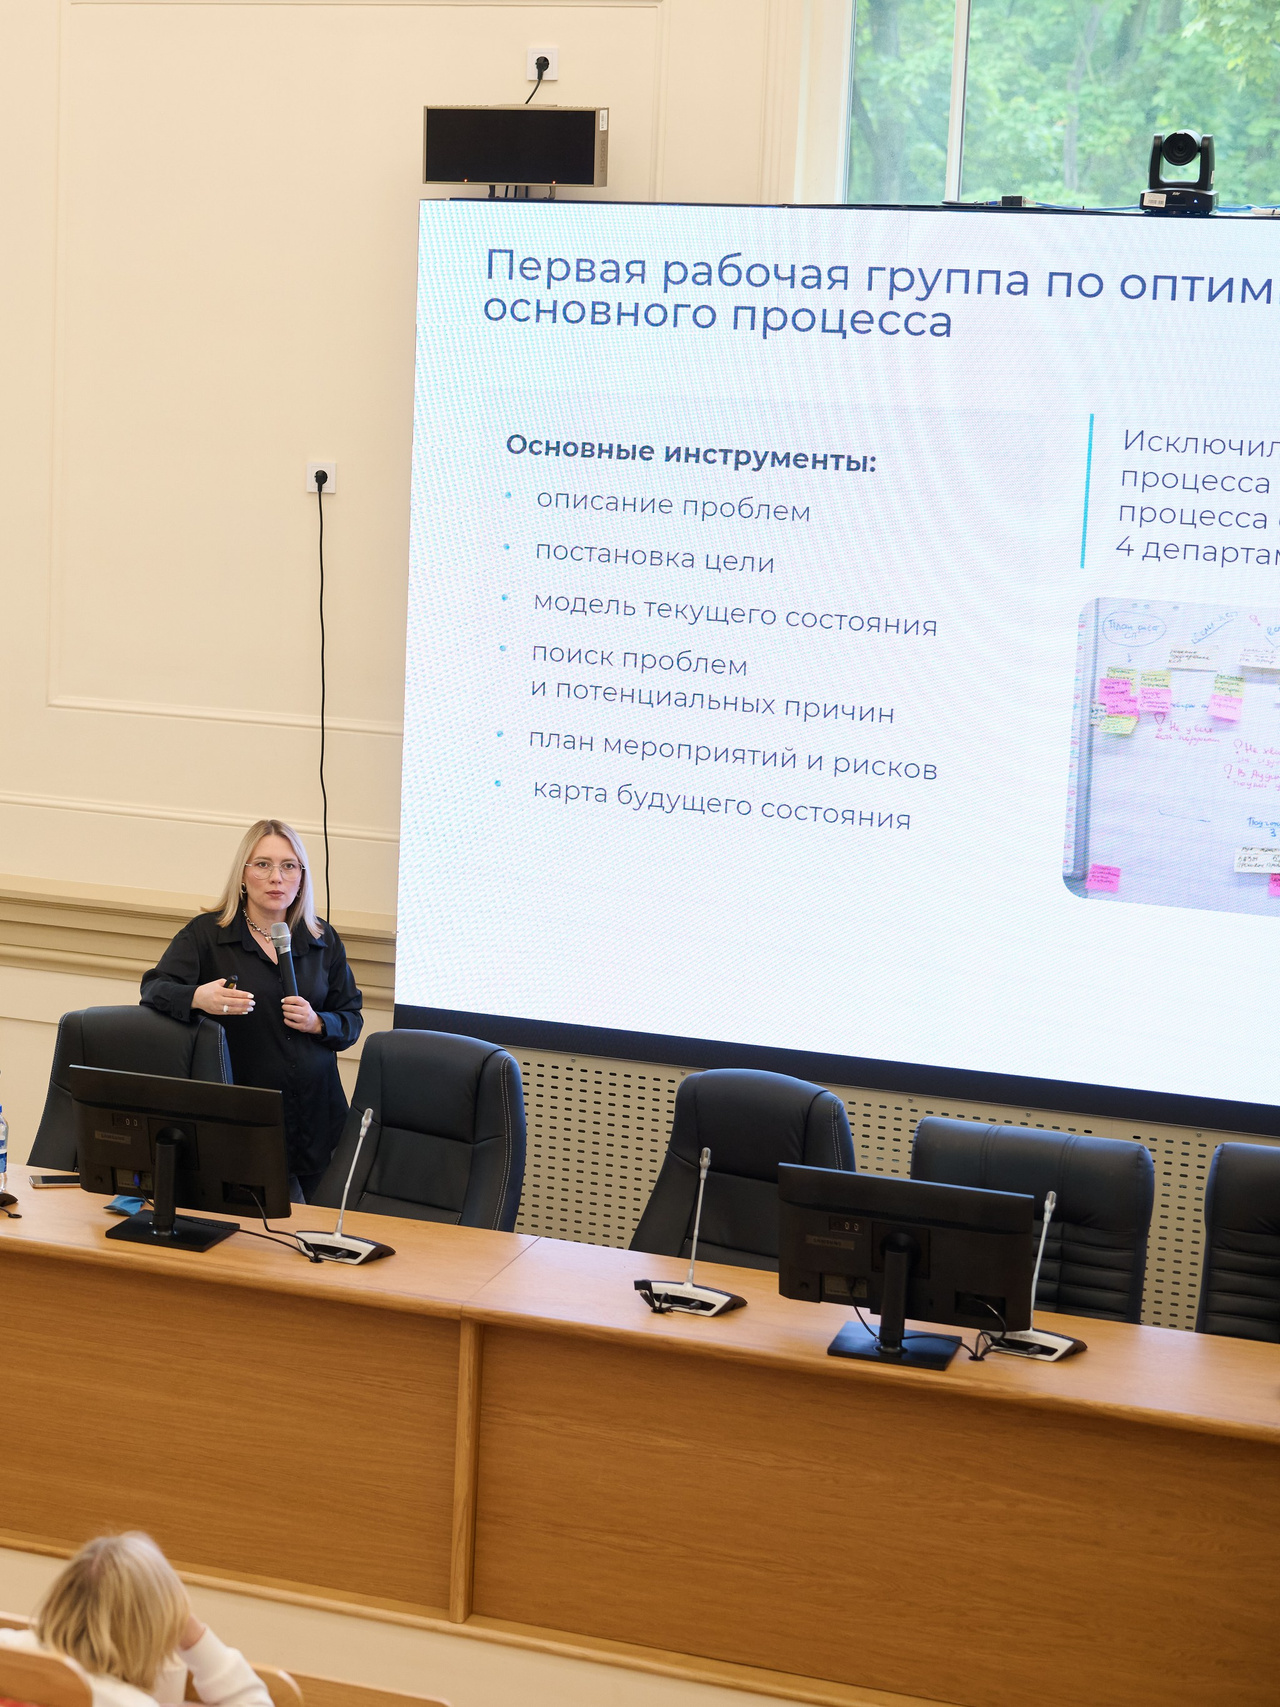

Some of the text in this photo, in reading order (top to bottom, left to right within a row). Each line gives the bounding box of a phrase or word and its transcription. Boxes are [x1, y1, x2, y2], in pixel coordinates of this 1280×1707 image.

[487, 248, 646, 290] Первая
[663, 251, 849, 294] рабочая
[867, 266, 1029, 302] группа
[1047, 271, 1104, 299] по
[483, 297, 952, 340] основного процесса
[506, 433, 877, 473] Основные инструменты:
[1123, 428, 1280, 458] Исключил
[1121, 469, 1271, 495] процесса
[536, 491, 811, 523] описание проблем
[1118, 504, 1268, 530] процесса
[535, 542, 775, 574] постановка цели
[1115, 535, 1280, 569] 4 департа
[534, 594, 938, 637] модель текущего состояния
[532, 644, 748, 677] поиск проблем
[531, 680, 895, 724] и потенциальных причин
[529, 730, 938, 781] план мероприятий и рисков
[533, 781, 911, 831] карта будущего состояния
